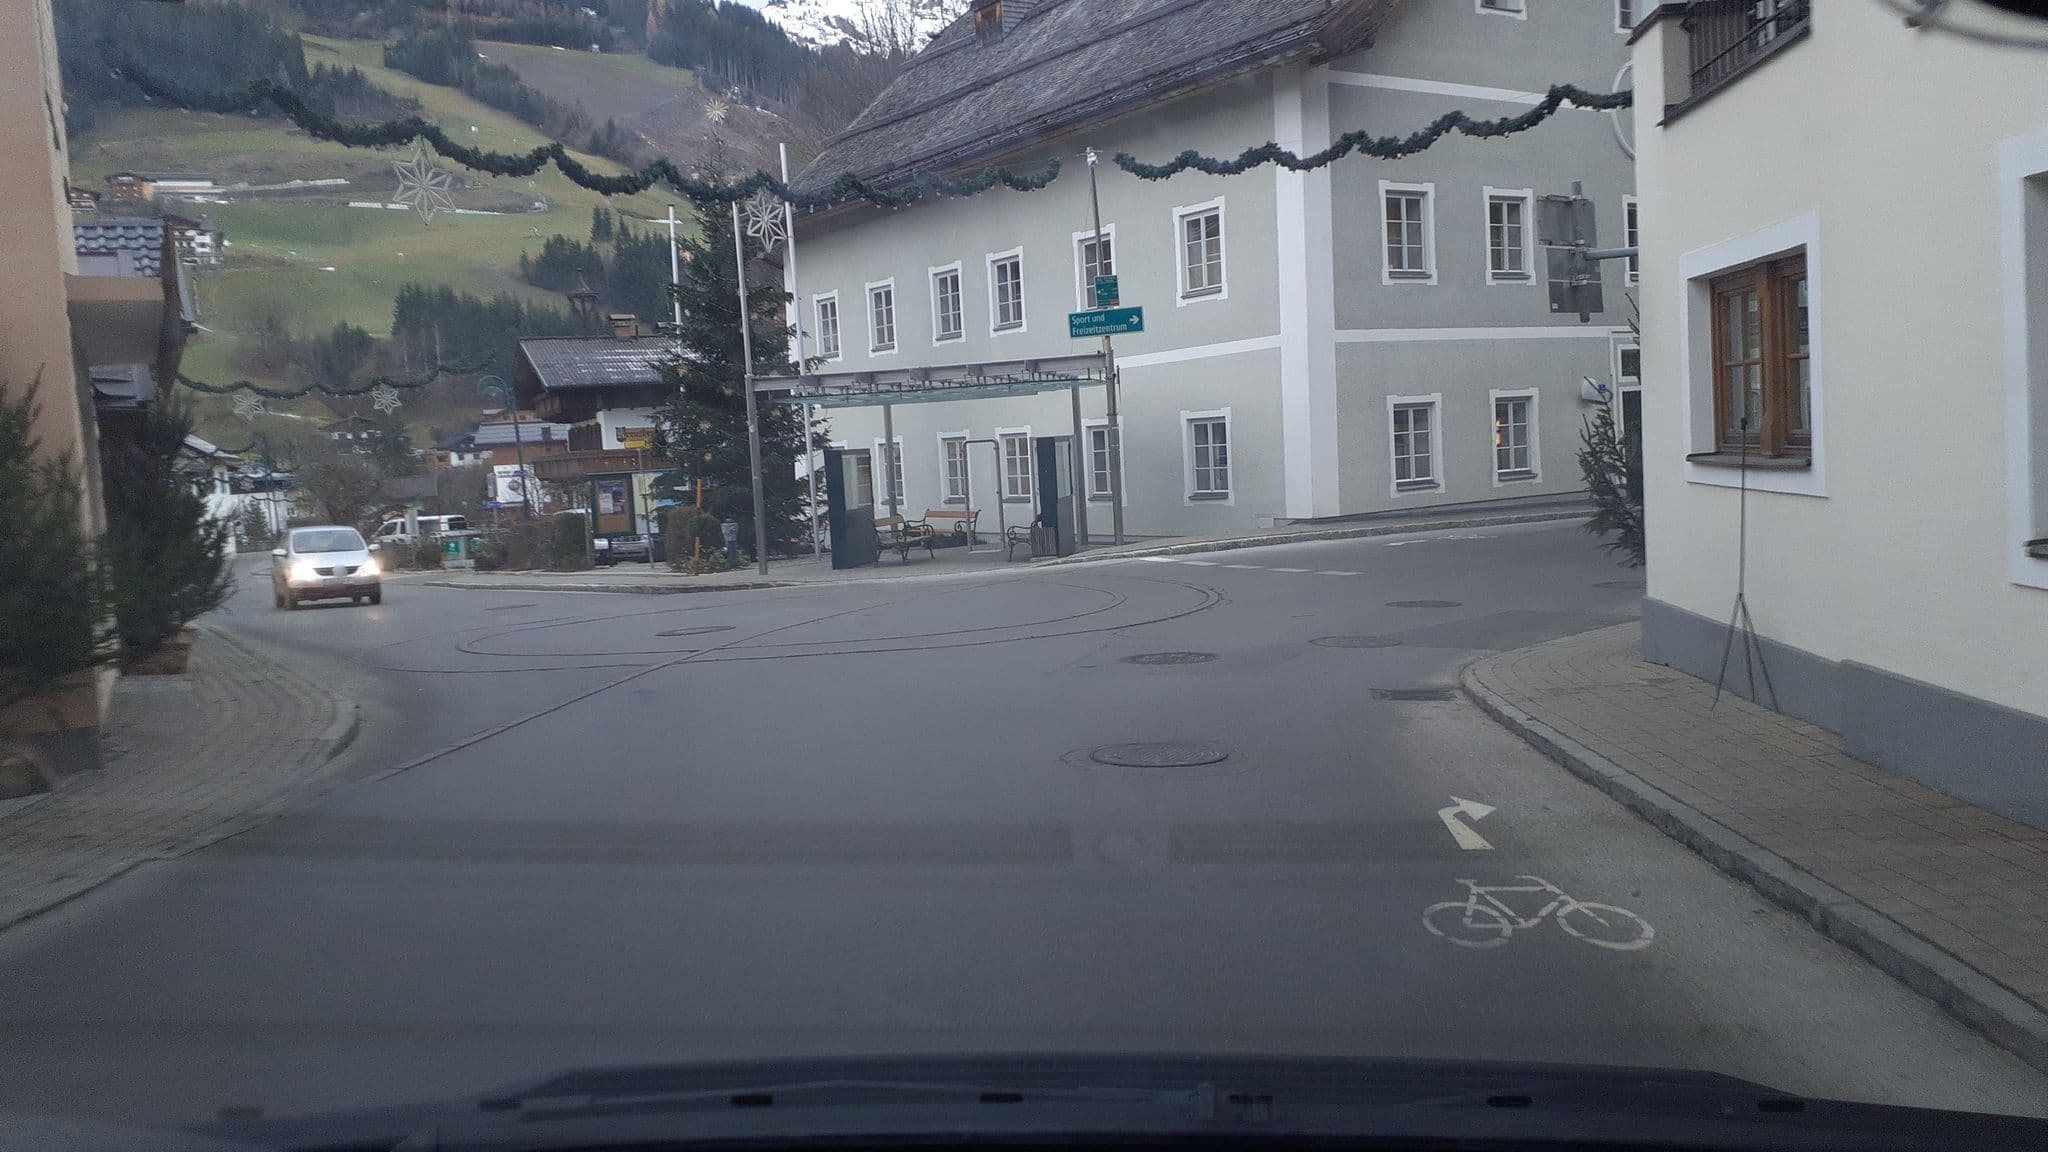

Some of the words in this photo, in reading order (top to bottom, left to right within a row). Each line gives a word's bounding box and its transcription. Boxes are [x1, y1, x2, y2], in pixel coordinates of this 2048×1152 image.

[1071, 315, 1090, 325] Sport
[1092, 313, 1105, 322] und
[1072, 323, 1127, 336] Freizeitzentrum
